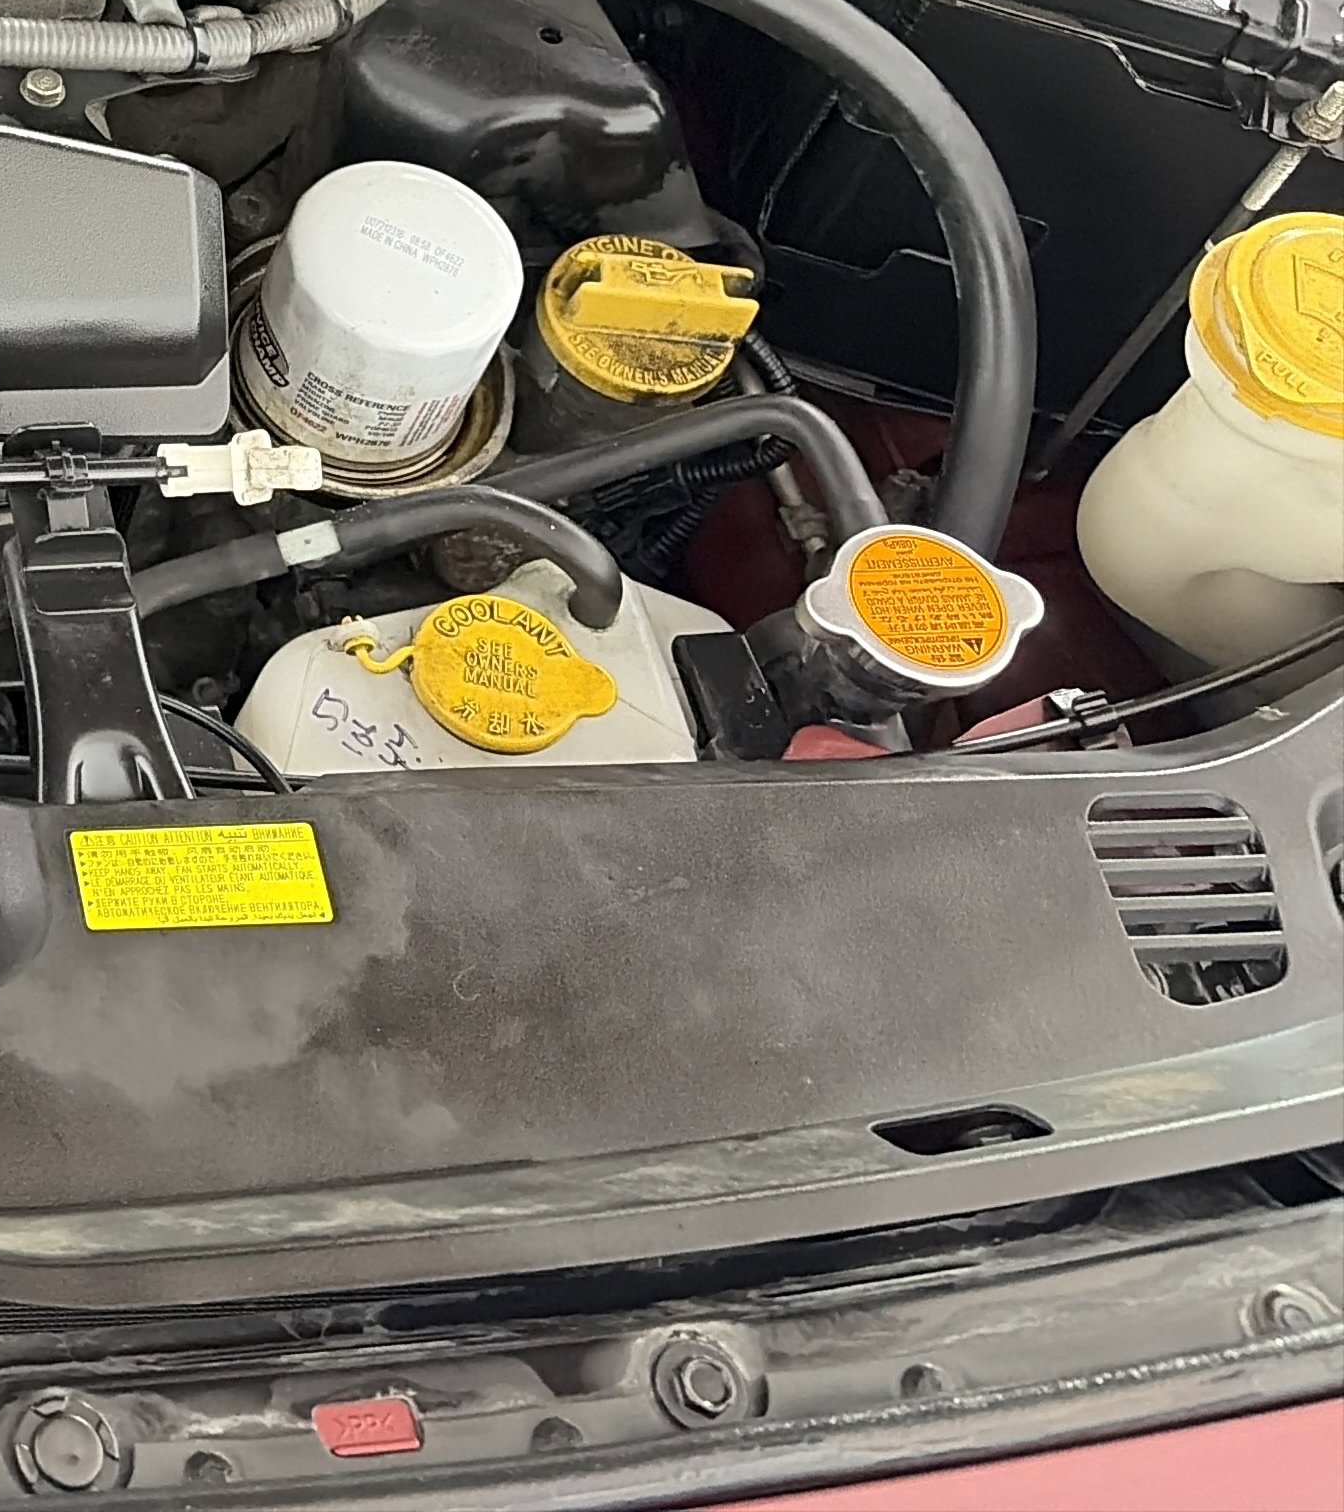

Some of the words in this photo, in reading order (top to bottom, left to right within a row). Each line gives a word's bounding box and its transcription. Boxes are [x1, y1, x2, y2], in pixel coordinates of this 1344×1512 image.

[360, 225, 385, 243] MADE
[394, 239, 419, 259] CHINA
[569, 333, 597, 360] SEE
[670, 349, 726, 386] MANUAL
[1255, 350, 1308, 398] PULL
[307, 371, 343, 398] CROSS
[345, 392, 413, 412] REFERENCE
[866, 556, 954, 570] AVERTISSEMENT
[866, 596, 896, 607] CHAUD
[893, 603, 925, 615] WHEN
[926, 603, 954, 613] OPEN
[957, 601, 991, 612] NEVER
[870, 605, 891, 616] HOT
[432, 598, 571, 659] COOLANT
[477, 637, 514, 660] SEE
[904, 642, 968, 656] WARNING
[465, 651, 539, 682] OWNERS
[464, 665, 537, 699] MANUAL
[120, 833, 159, 846] CAUTION
[164, 830, 212, 843] ATTENTION
[253, 827, 305, 840] ВНИМАНИЕ
[89, 869, 110, 878] KEEP
[114, 867, 142, 877] HANDS
[175, 866, 193, 875] FAN
[196, 863, 228, 873] STARTS
[91, 877, 101, 888] LE
[155, 875, 166, 885] DU
[170, 872, 225, 885] VENTILATEUR
[92, 887, 116, 897] N'EN
[120, 885, 170, 896] APPROCHEZ
[173, 884, 192, 895] PAS
[196, 883, 213, 894] LES
[216, 882, 250, 893] MAINS.
[95, 897, 140, 908] ДЕРЖИТЕ
[143, 896, 169, 907] РУКИ
[97, 905, 187, 918] АВТОМАТИЧЕСКОЕ
